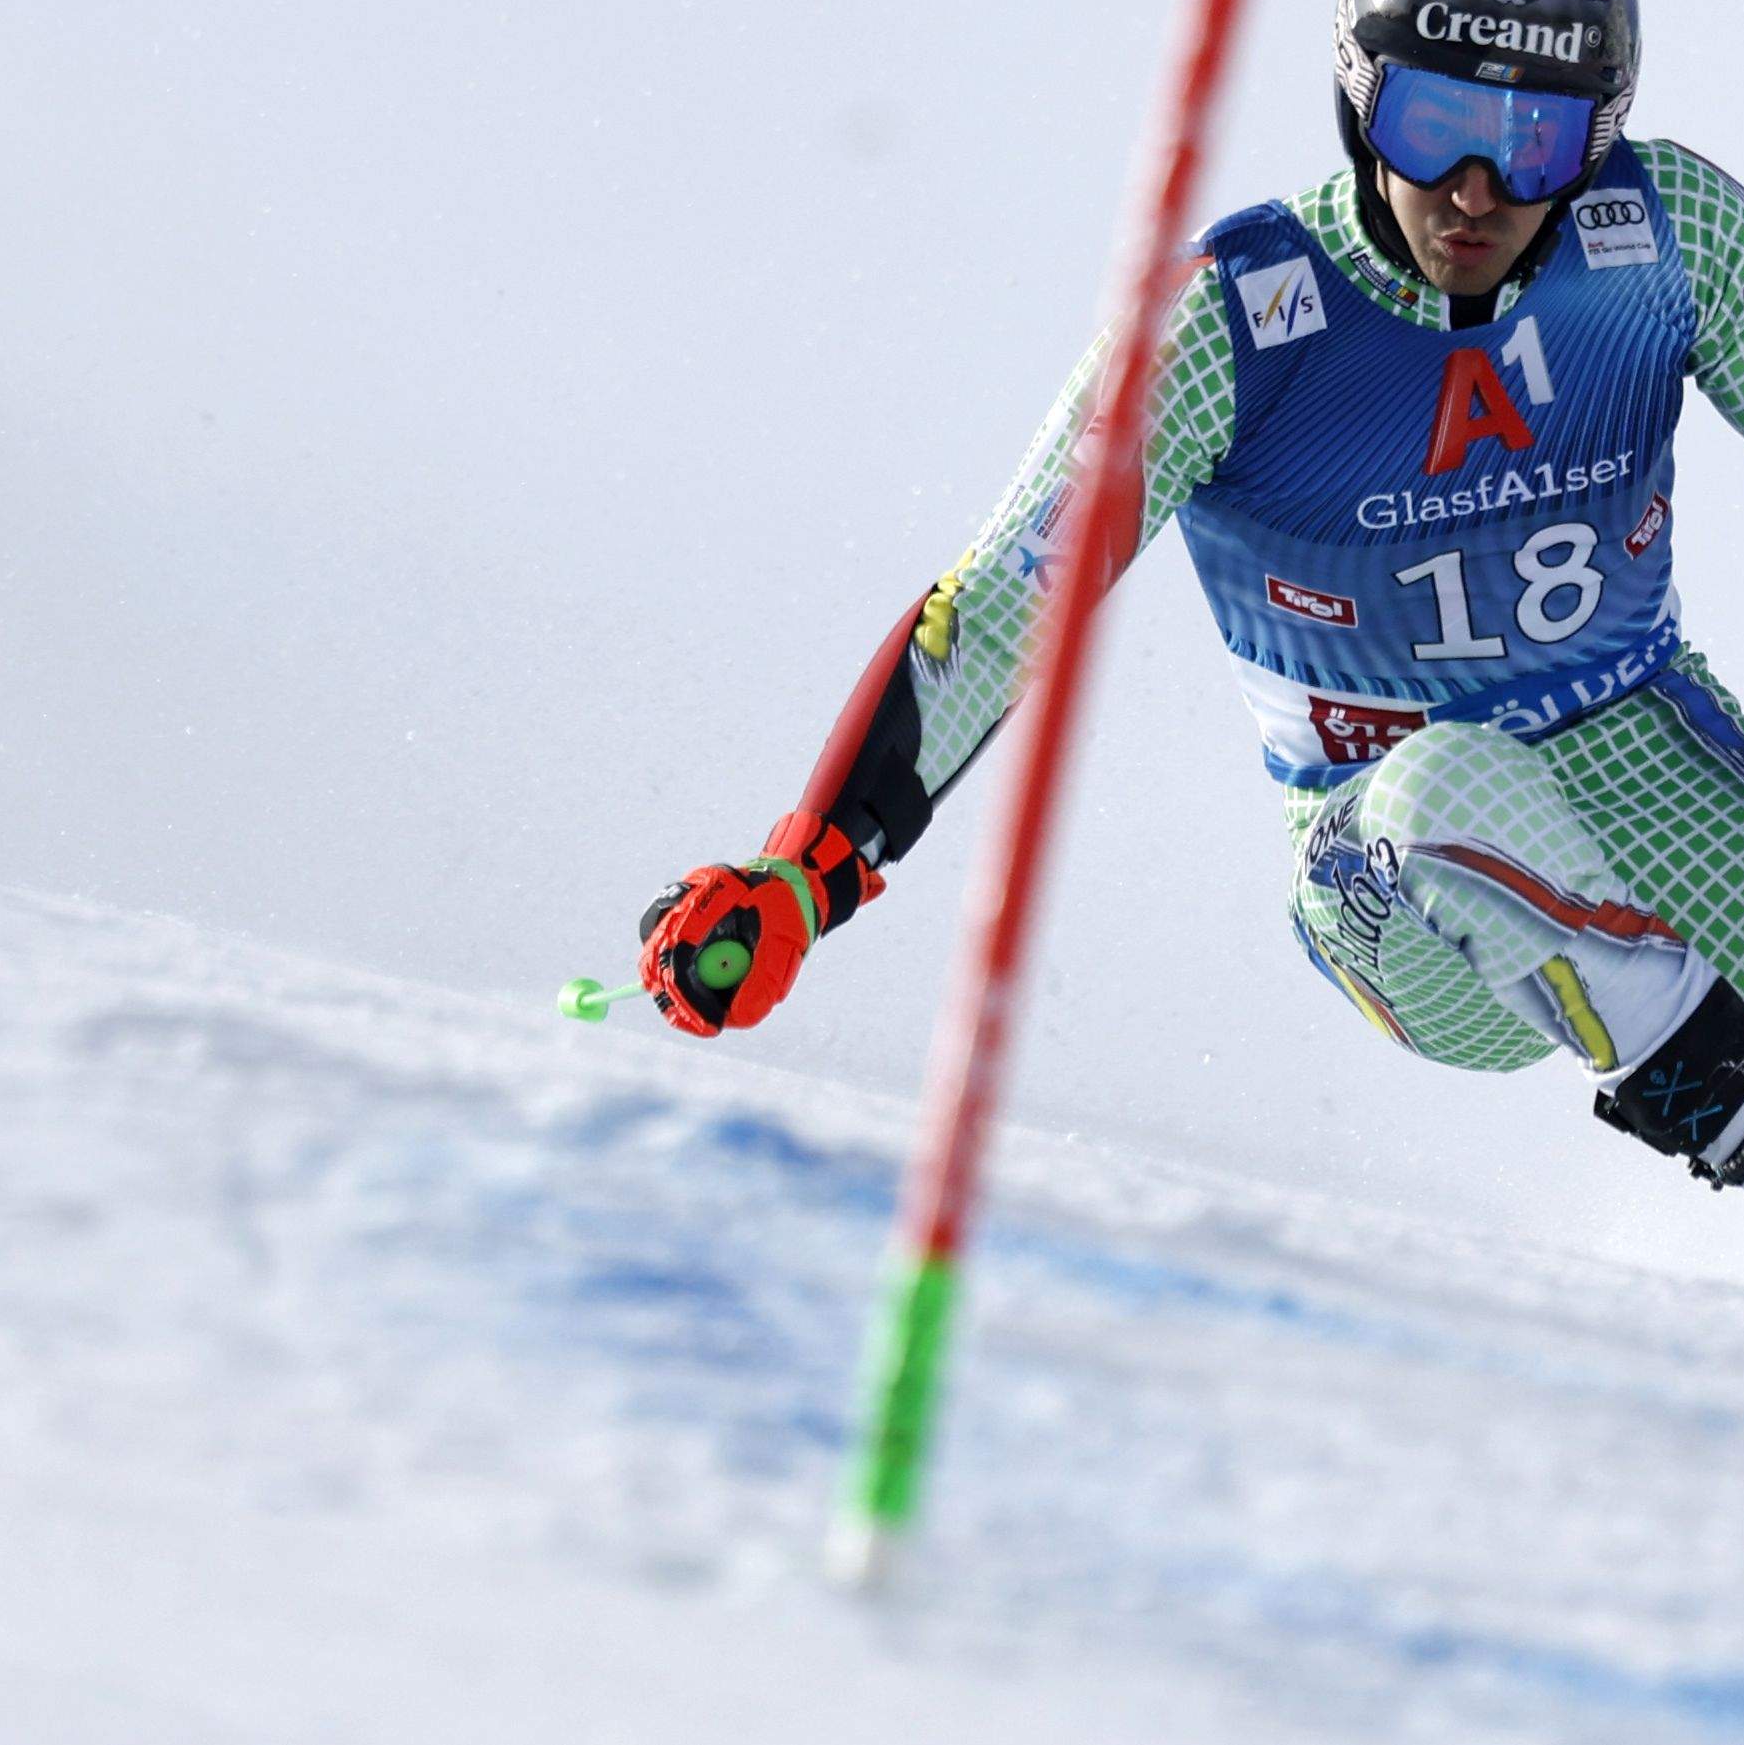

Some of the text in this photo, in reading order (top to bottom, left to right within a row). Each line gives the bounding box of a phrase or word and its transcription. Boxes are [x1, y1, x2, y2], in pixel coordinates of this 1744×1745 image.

[1253, 295, 1313, 329] FIS
[1423, 315, 1554, 477] A1
[1356, 448, 1634, 534] GlasfA1ser
[1631, 500, 1664, 547] Tirol
[1278, 585, 1343, 618] Tirol
[1394, 521, 1606, 662] 18
